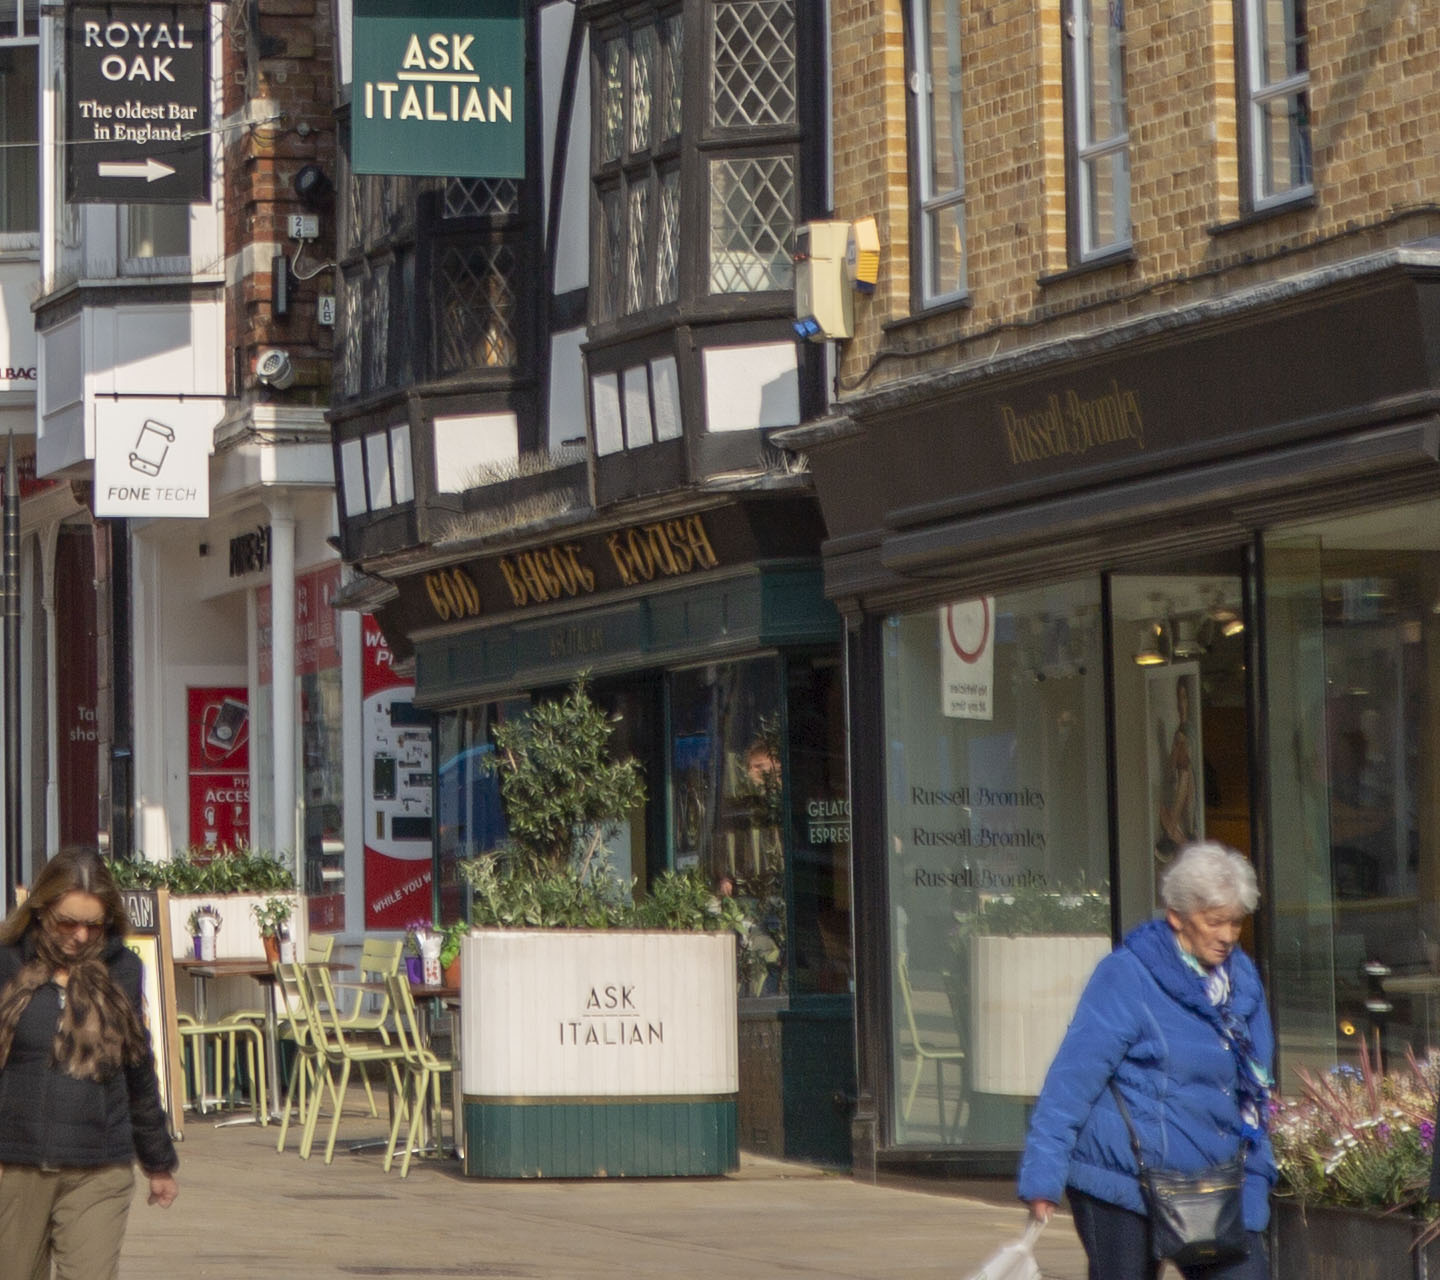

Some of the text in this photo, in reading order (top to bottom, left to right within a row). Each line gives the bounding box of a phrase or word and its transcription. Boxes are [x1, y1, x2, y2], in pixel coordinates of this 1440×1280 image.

[84, 20, 194, 49] ROYAL
[402, 33, 476, 71] ASK
[101, 54, 176, 82] OAK
[78, 99, 198, 120] The oldest Bar
[364, 81, 513, 123] ITALIAN
[93, 122, 182, 144] in England
[107, 486, 197, 502] FONE TECH
[911, 786, 970, 807] Russell
[979, 786, 1046, 810] Bromley
[912, 827, 972, 847] Russell
[980, 827, 1047, 851] Bromley
[913, 868, 973, 888] Russell
[372, 889, 403, 914] WHILE
[402, 877, 423, 896] YOU
[586, 984, 637, 1010] ASK
[559, 1020, 665, 1046] ITALIAN
